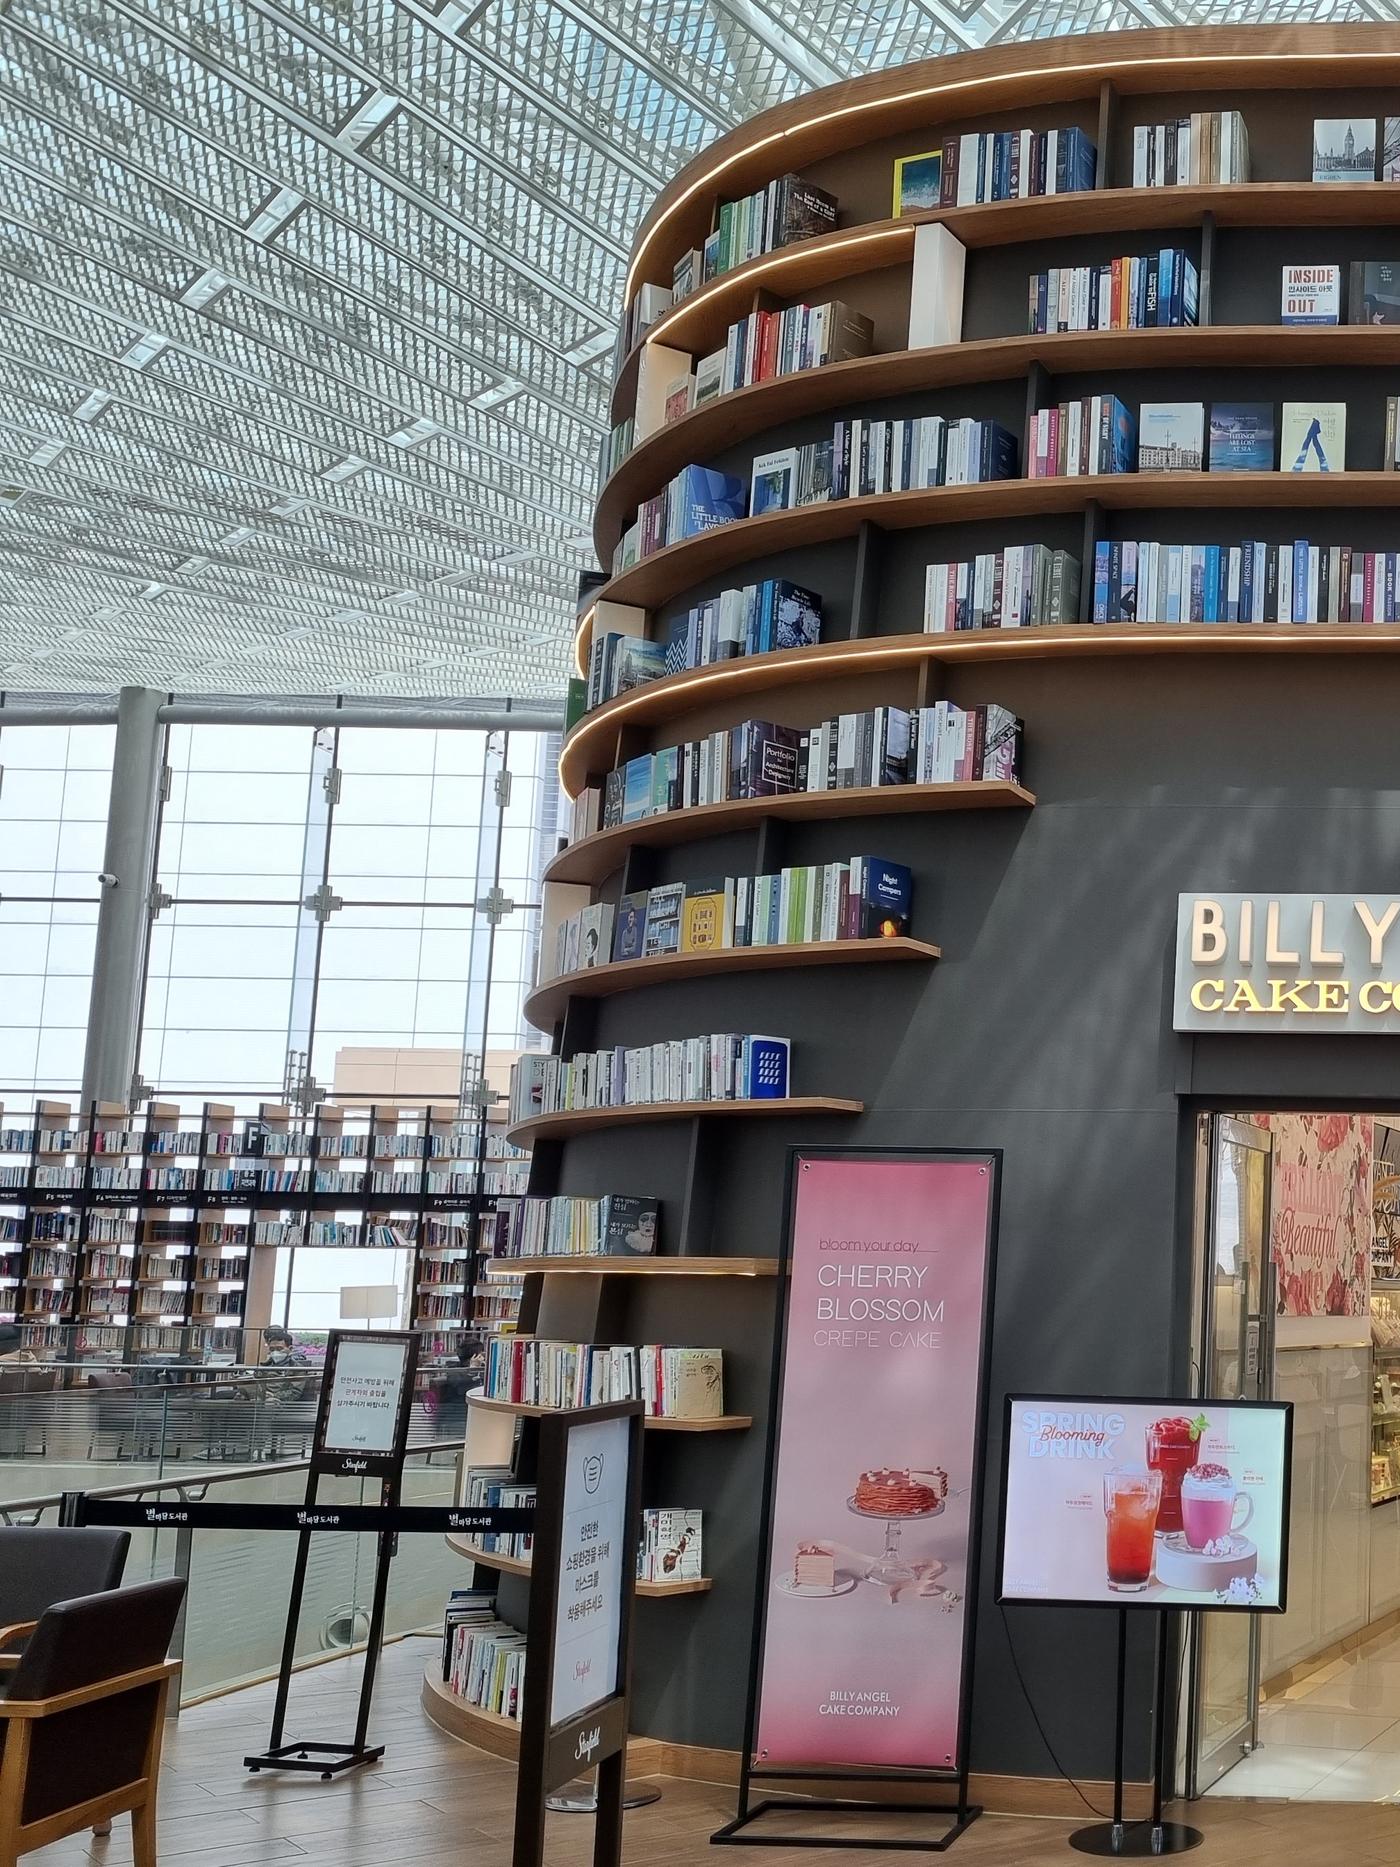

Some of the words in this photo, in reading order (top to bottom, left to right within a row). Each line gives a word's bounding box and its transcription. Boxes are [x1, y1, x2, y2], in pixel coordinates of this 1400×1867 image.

[1288, 269, 1333, 284] INSIDE
[1288, 285, 1317, 293] 인사이드
[1148, 292, 1156, 311] FISH
[1288, 299, 1315, 313] OUT
[691, 504, 705, 513] THE
[691, 512, 718, 523] LITTLE
[766, 747, 795, 761] Portfolio
[883, 873, 897, 885] Night
[878, 884, 901, 895] Campers
[1190, 979, 1349, 1014] CAKE
[249, 1126, 258, 1150] F
[46, 1193, 54, 1201] F5
[820, 1239, 861, 1252] bloom
[863, 1241, 892, 1253] your
[893, 1240, 919, 1253] day
[1371, 1237, 1388, 1249] ANGEL
[818, 1265, 928, 1288] CHERRY
[817, 1298, 944, 1322] BLOSSOM
[814, 1329, 880, 1348] CREPE
[889, 1331, 942, 1349] CAKE
[1022, 1411, 1126, 1436] SPRING
[1040, 1424, 1105, 1448] Blooming
[1027, 1435, 1117, 1461] DRINK
[580, 1520, 599, 1541] 안전한
[566, 1544, 596, 1571] 쇼핑환경을
[597, 1541, 610, 1560] 위해
[575, 1571, 600, 1593] 마스크를
[567, 1594, 603, 1623] 착용해주세요
[830, 1691, 855, 1701] BILLY
[856, 1692, 891, 1702] ANGEL
[819, 1704, 846, 1715] CAKE
[847, 1705, 900, 1716] COMPANY
